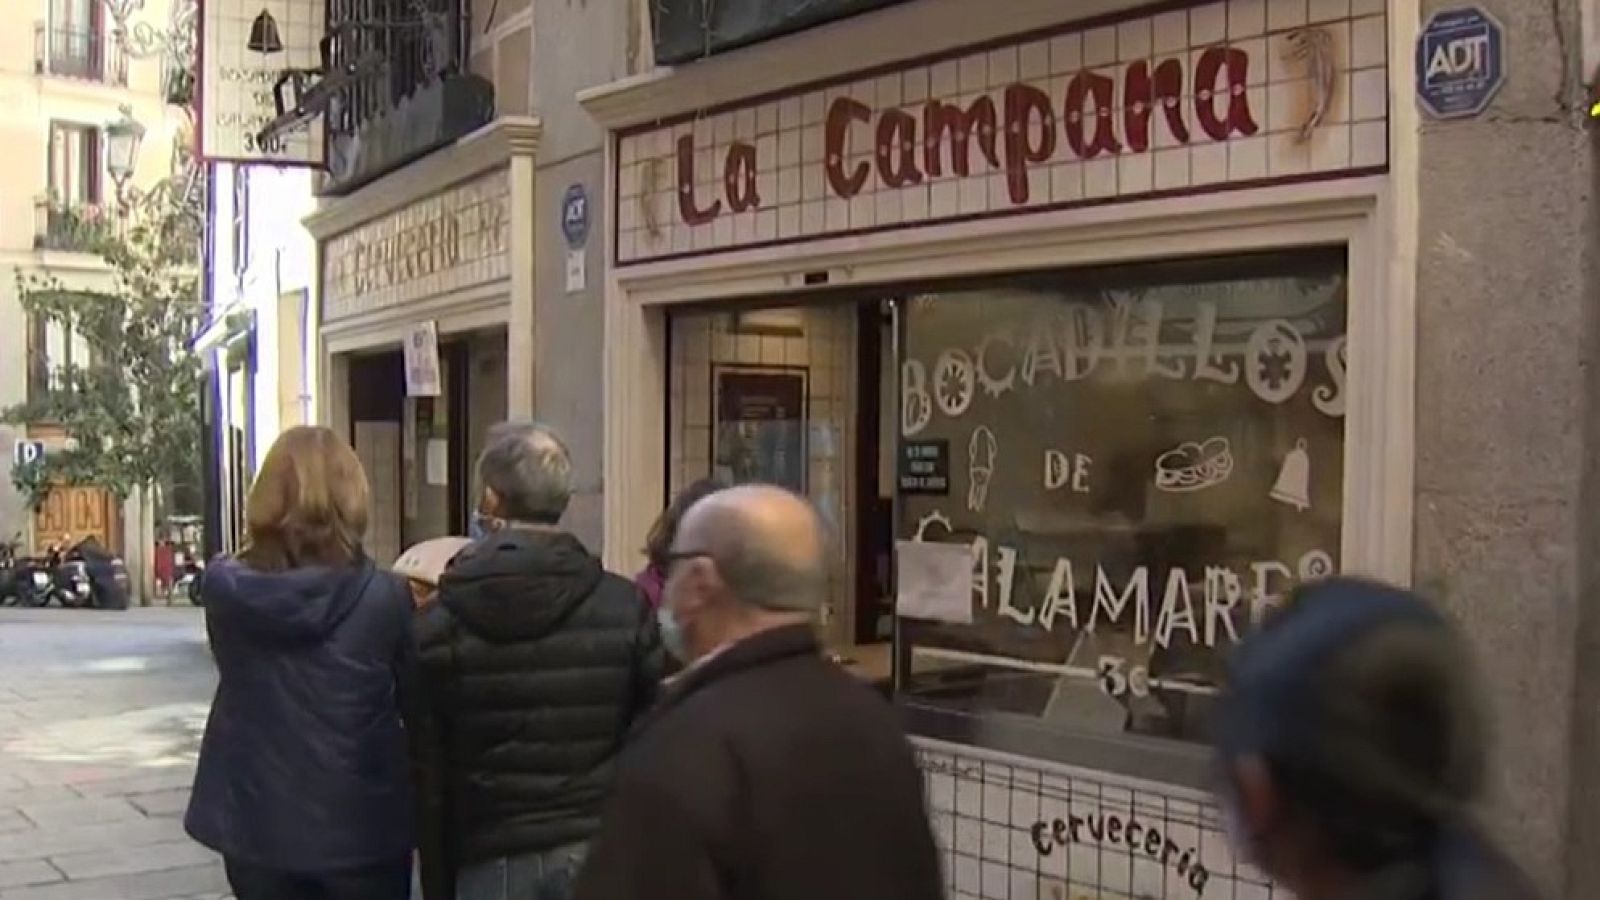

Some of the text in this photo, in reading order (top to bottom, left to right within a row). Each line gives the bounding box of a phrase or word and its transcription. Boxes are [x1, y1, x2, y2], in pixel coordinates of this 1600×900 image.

[1427, 35, 1489, 78] ADT
[676, 47, 1259, 227] La Campana
[1045, 449, 1093, 493] DE
